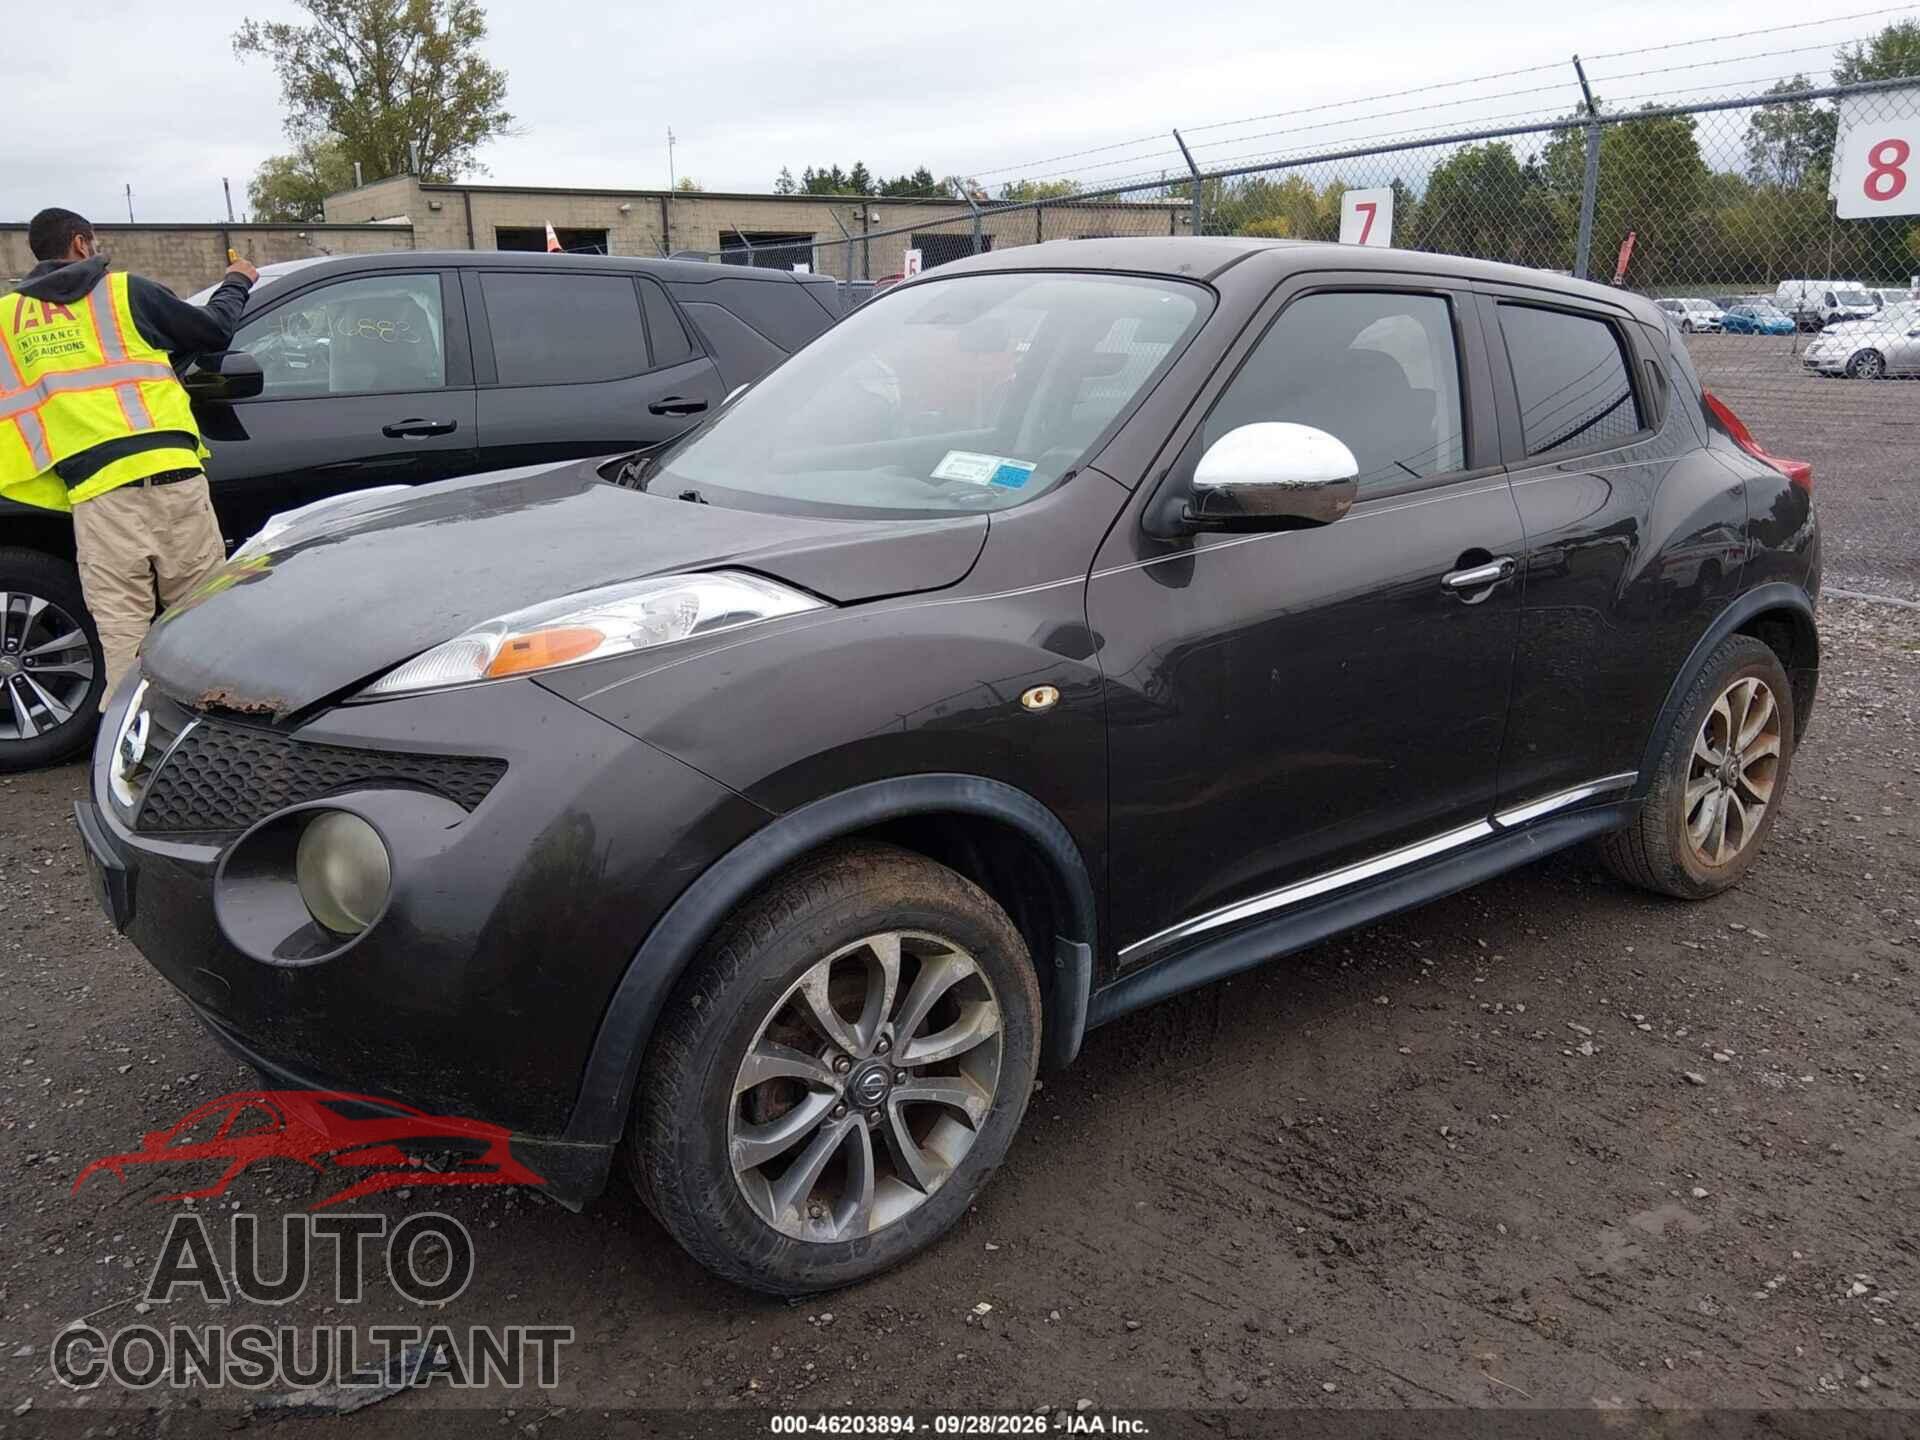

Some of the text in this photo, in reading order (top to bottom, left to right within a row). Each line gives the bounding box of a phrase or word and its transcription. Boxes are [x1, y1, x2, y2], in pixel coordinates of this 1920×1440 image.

[1863, 138, 1910, 202] 8
[1355, 202, 1377, 245] 7
[41, 341, 86, 356] AUCTIONS
